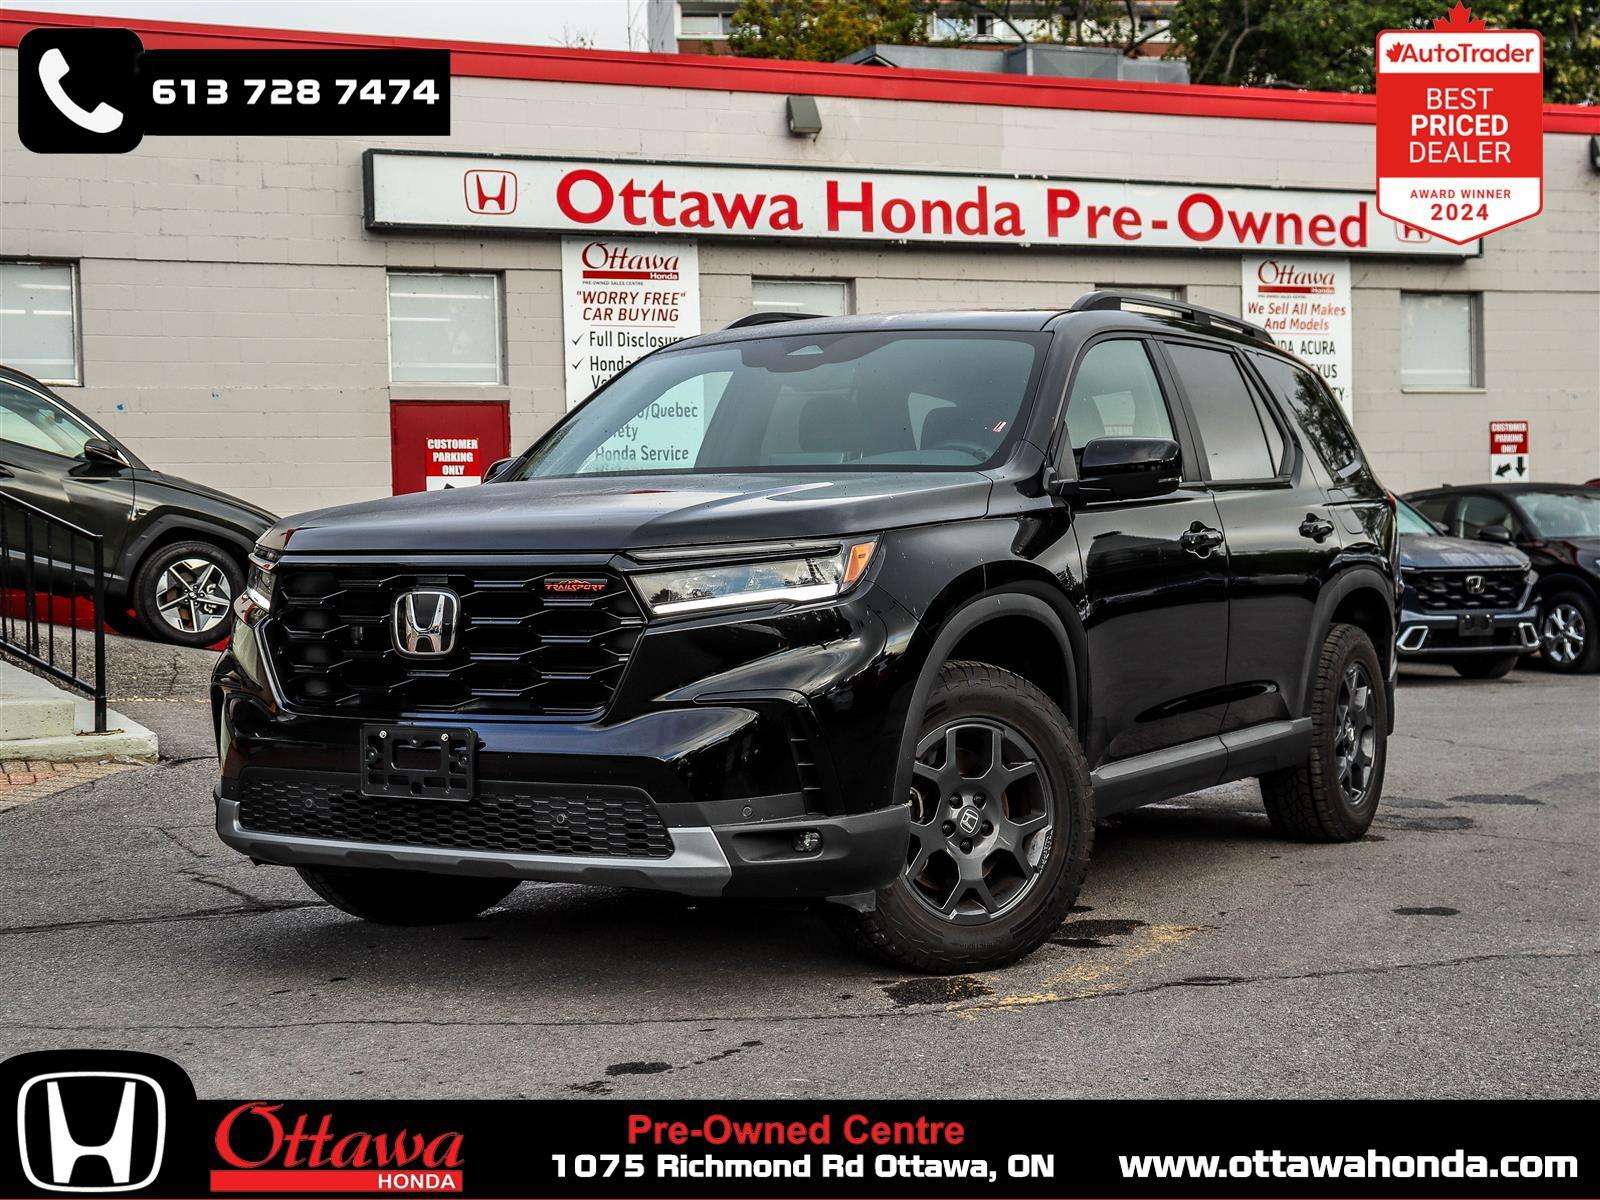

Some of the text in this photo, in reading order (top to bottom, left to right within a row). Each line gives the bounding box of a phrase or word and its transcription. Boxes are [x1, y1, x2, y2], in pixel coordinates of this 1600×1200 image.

[556, 169, 803, 232] Ottawa
[826, 180, 1025, 237] Honda
[1047, 188, 1368, 248] Pre-Owned
[581, 241, 679, 271] Ottawa
[650, 272, 678, 280] Honda
[1258, 259, 1335, 285] Ottawa
[577, 291, 686, 305] "WORRY FREE"
[583, 307, 679, 322] CAR BUYING
[1248, 301, 1347, 316] We Sell All Makes
[1265, 318, 1330, 331] And Models
[589, 331, 613, 348] Full
[1300, 340, 1336, 355] ACURA
[1310, 363, 1338, 378] XUS
[427, 438, 478, 450] CUSTOMER
[432, 451, 474, 463] PARKING
[595, 444, 689, 462] Honda Service
[442, 464, 465, 476] ONLY
[544, 583, 607, 592] TRAILSPORT
